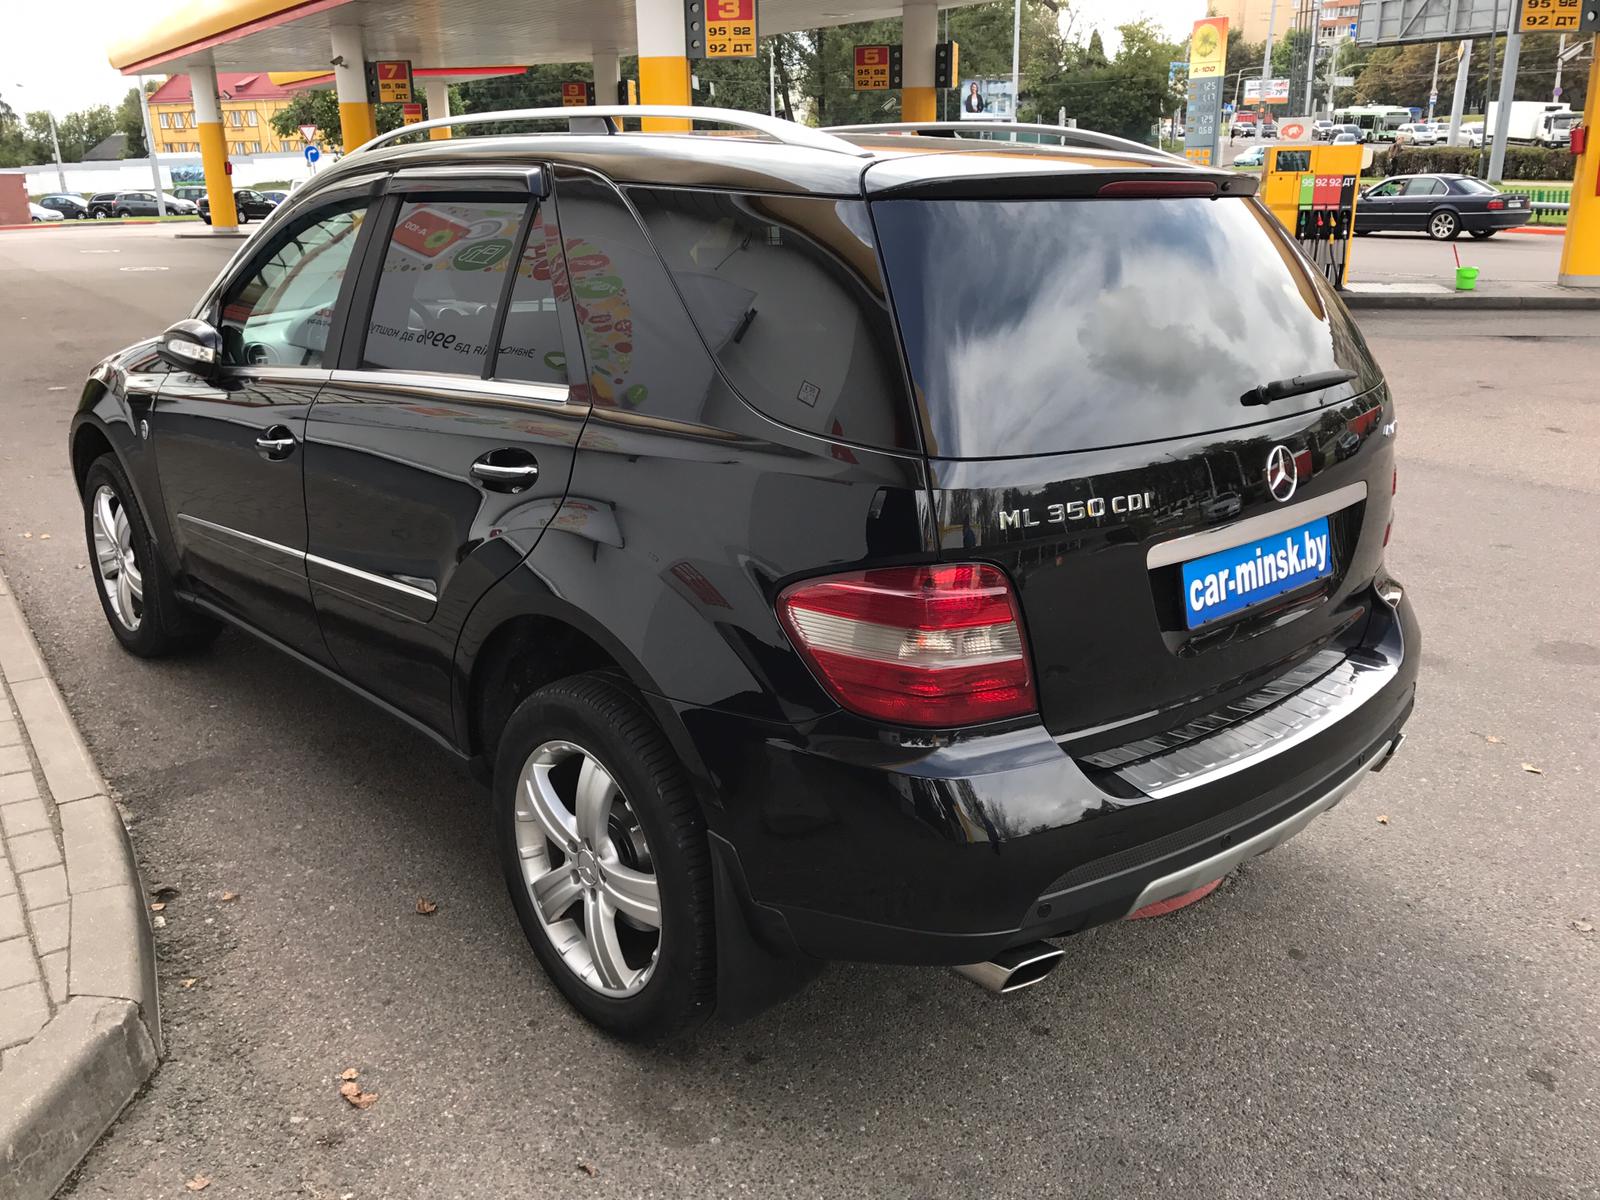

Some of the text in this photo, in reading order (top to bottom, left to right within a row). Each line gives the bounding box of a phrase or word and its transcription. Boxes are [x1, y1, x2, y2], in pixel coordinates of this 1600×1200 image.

[718, 0, 740, 19] 3
[1528, 0, 1551, 8] 95
[1526, 16, 1577, 26] 92 ДТ
[708, 26, 751, 36] 95 92
[709, 44, 752, 53] 92 ДТ
[864, 49, 880, 64] 5
[384, 64, 398, 79] 7
[1302, 177, 1355, 187] 95 92 92 ДТ
[1000, 492, 1151, 530] ML 350 CDI
[1190, 531, 1327, 612] car-minsk.by
